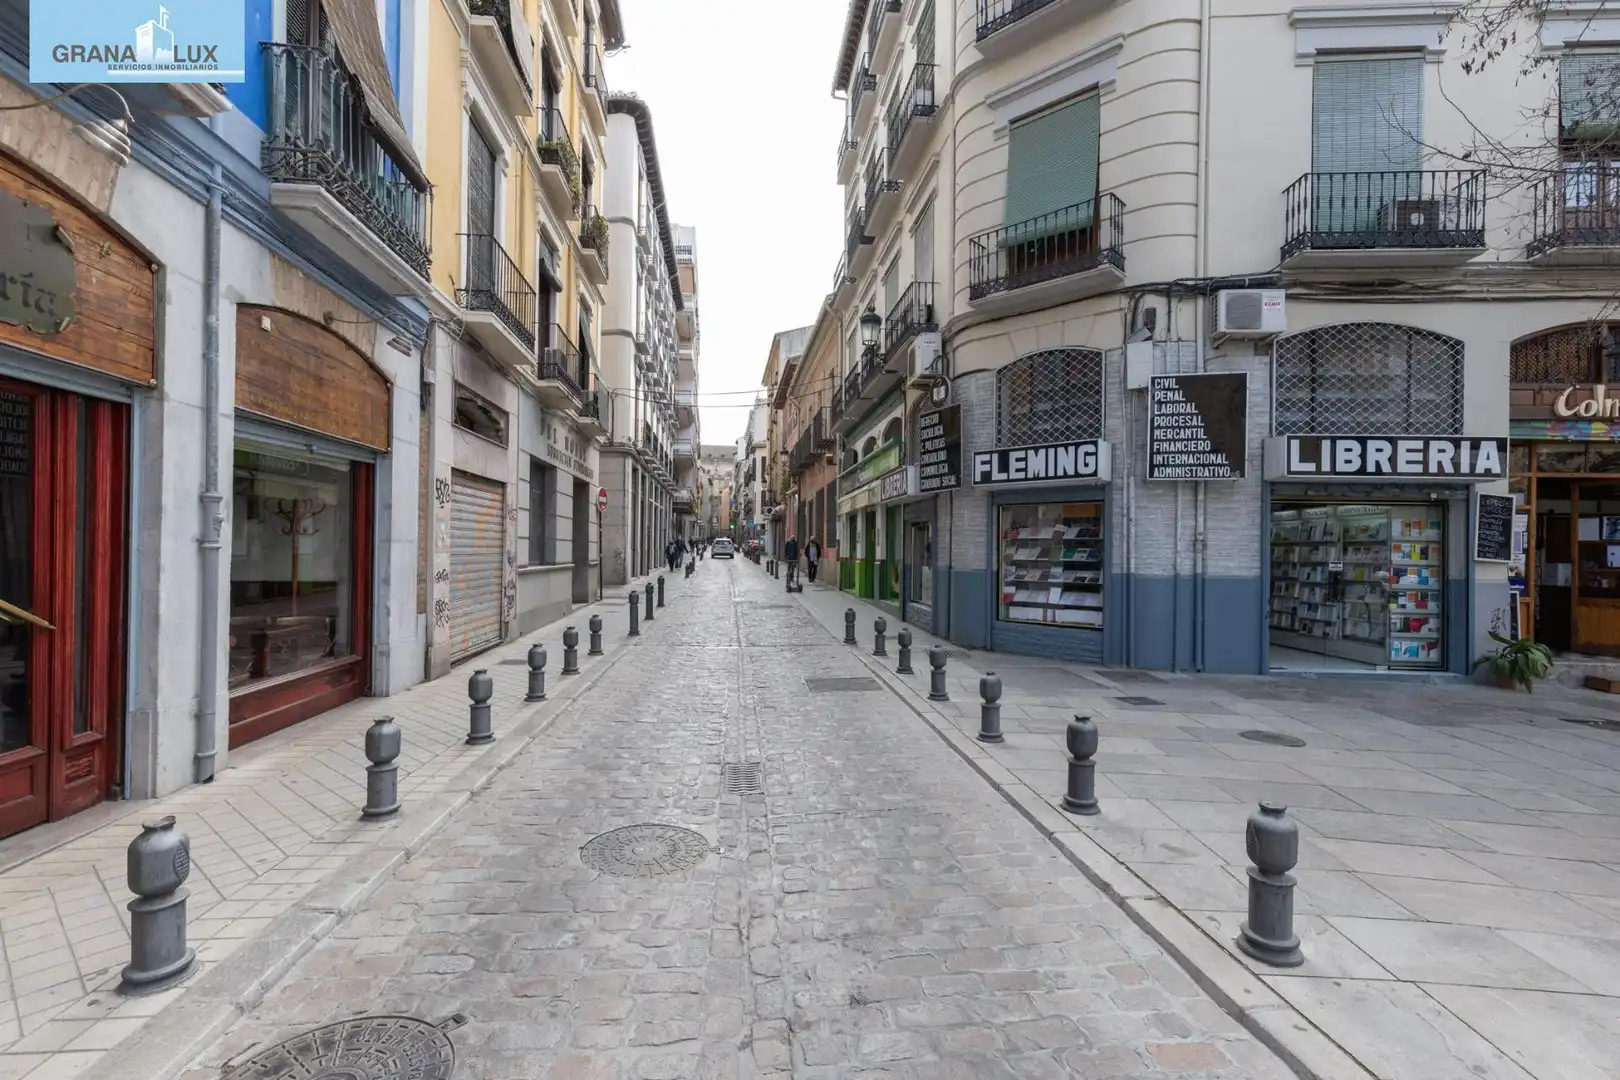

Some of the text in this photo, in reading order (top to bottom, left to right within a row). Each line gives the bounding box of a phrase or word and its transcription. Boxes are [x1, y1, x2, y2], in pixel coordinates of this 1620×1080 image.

[1154, 378, 1179, 389] CIVIL
[1154, 390, 1186, 402] PENAL
[1154, 402, 1199, 414] LABORAL
[1154, 415, 1204, 427] PROCESAL
[1153, 428, 1208, 440] MERCANTIL
[1153, 440, 1211, 452] FINANCIERO
[974, 443, 1097, 482] FLEMING
[1153, 453, 1229, 465] INTERNACIONAL
[1289, 438, 1503, 475] LIBRERIA
[1153, 466, 1231, 478] ADMINISTRATIVO
